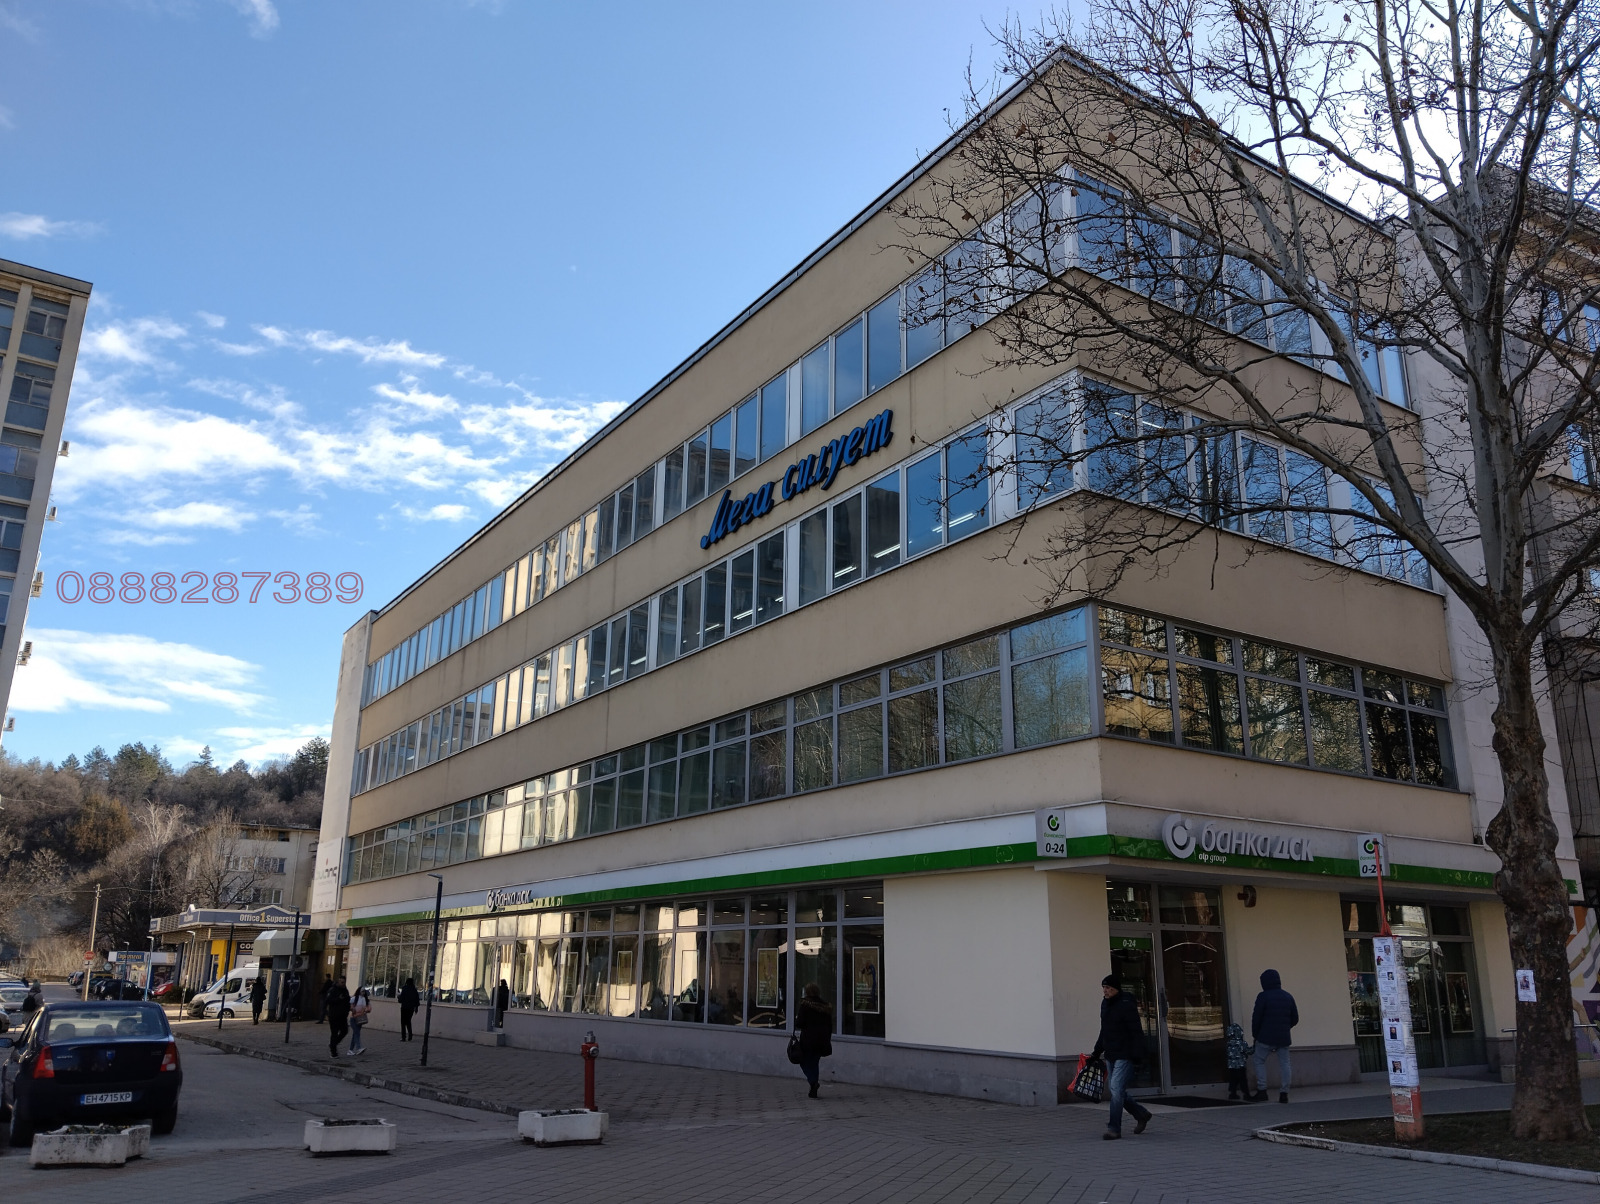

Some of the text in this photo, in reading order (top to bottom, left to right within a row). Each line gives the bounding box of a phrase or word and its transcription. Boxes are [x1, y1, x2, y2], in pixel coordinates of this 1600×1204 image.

[1201, 820, 1271, 858] банка
[1045, 842, 1065, 854] 0-24
[1209, 855, 1227, 864] group
[239, 911, 303, 924] Office 1 Superstoe
[1122, 939, 1136, 948] 0-24
